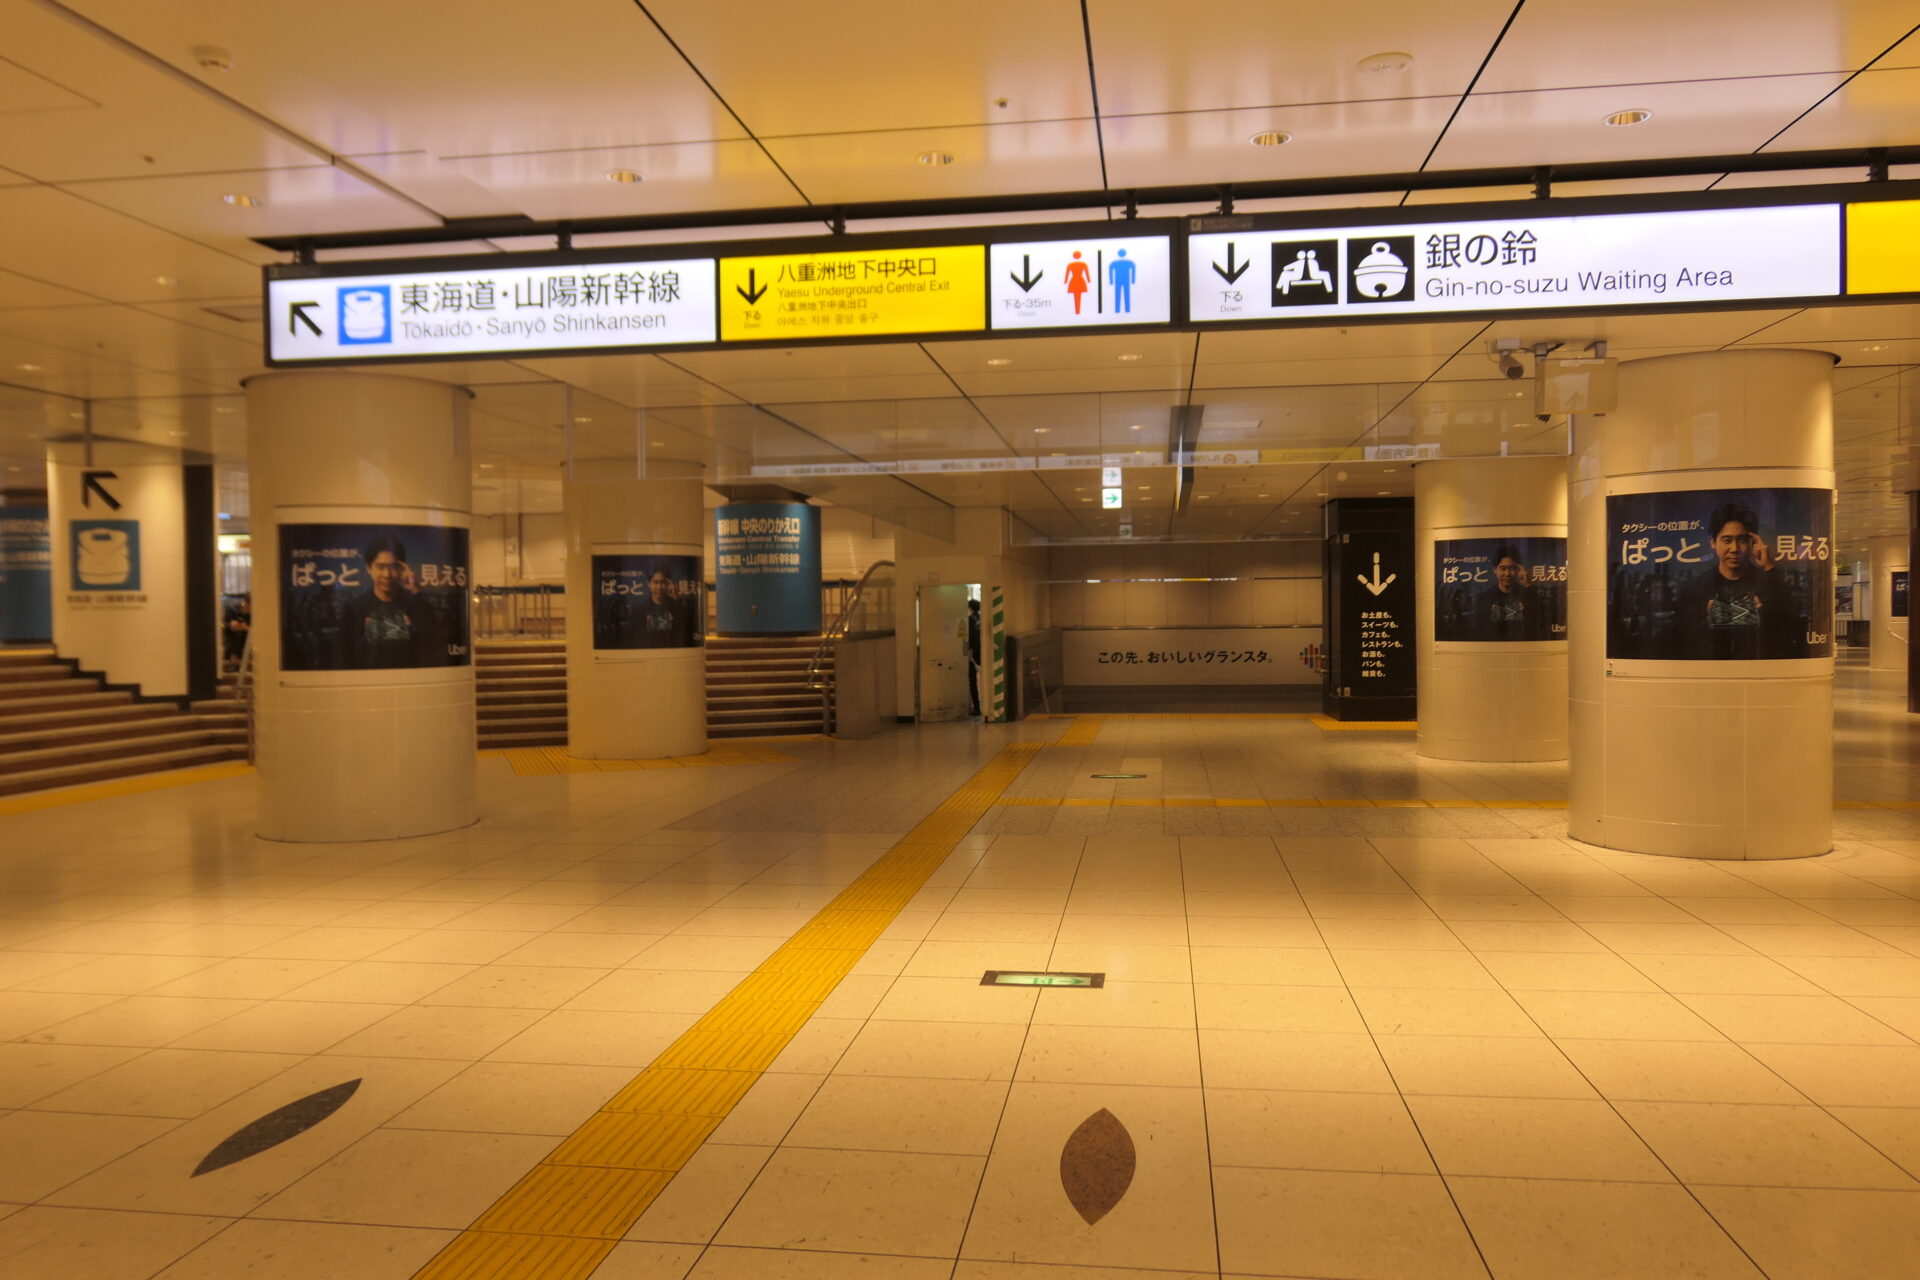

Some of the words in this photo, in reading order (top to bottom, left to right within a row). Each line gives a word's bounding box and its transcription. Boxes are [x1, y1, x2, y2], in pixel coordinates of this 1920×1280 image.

[1426, 229, 1538, 269] 銀の鈴
[777, 257, 937, 283] 八重洲地下中央口
[777, 286, 811, 299] Yaesu
[813, 281, 883, 298] Underground
[886, 280, 926, 294] Central
[929, 278, 950, 291] Exit
[1425, 277, 1569, 298] Gin-no-suzu
[1578, 268, 1667, 293] Waiting
[1676, 267, 1734, 288] Area
[400, 268, 681, 315] 東海道・山陽新幹線
[1220, 290, 1243, 303] 下る
[1219, 304, 1243, 313] Down
[553, 312, 666, 332] Shinkansen
[1621, 520, 1705, 533] タクシーの位置が、
[1621, 537, 1702, 565] ぱっと
[1775, 535, 1829, 561] 見える
[292, 562, 361, 588] ぱっと
[420, 564, 467, 587] 見える
[1443, 566, 1489, 584] ぱっと
[1531, 564, 1568, 582] 見える
[1361, 621, 1399, 629] スイーツも。
[1551, 624, 1567, 633] Uber
[1361, 631, 1391, 639] カフェも。
[1806, 631, 1828, 645] Uber
[1361, 640, 1404, 649] レストランも。
[1098, 650, 1273, 664] この先、おいしいグランスタ。
